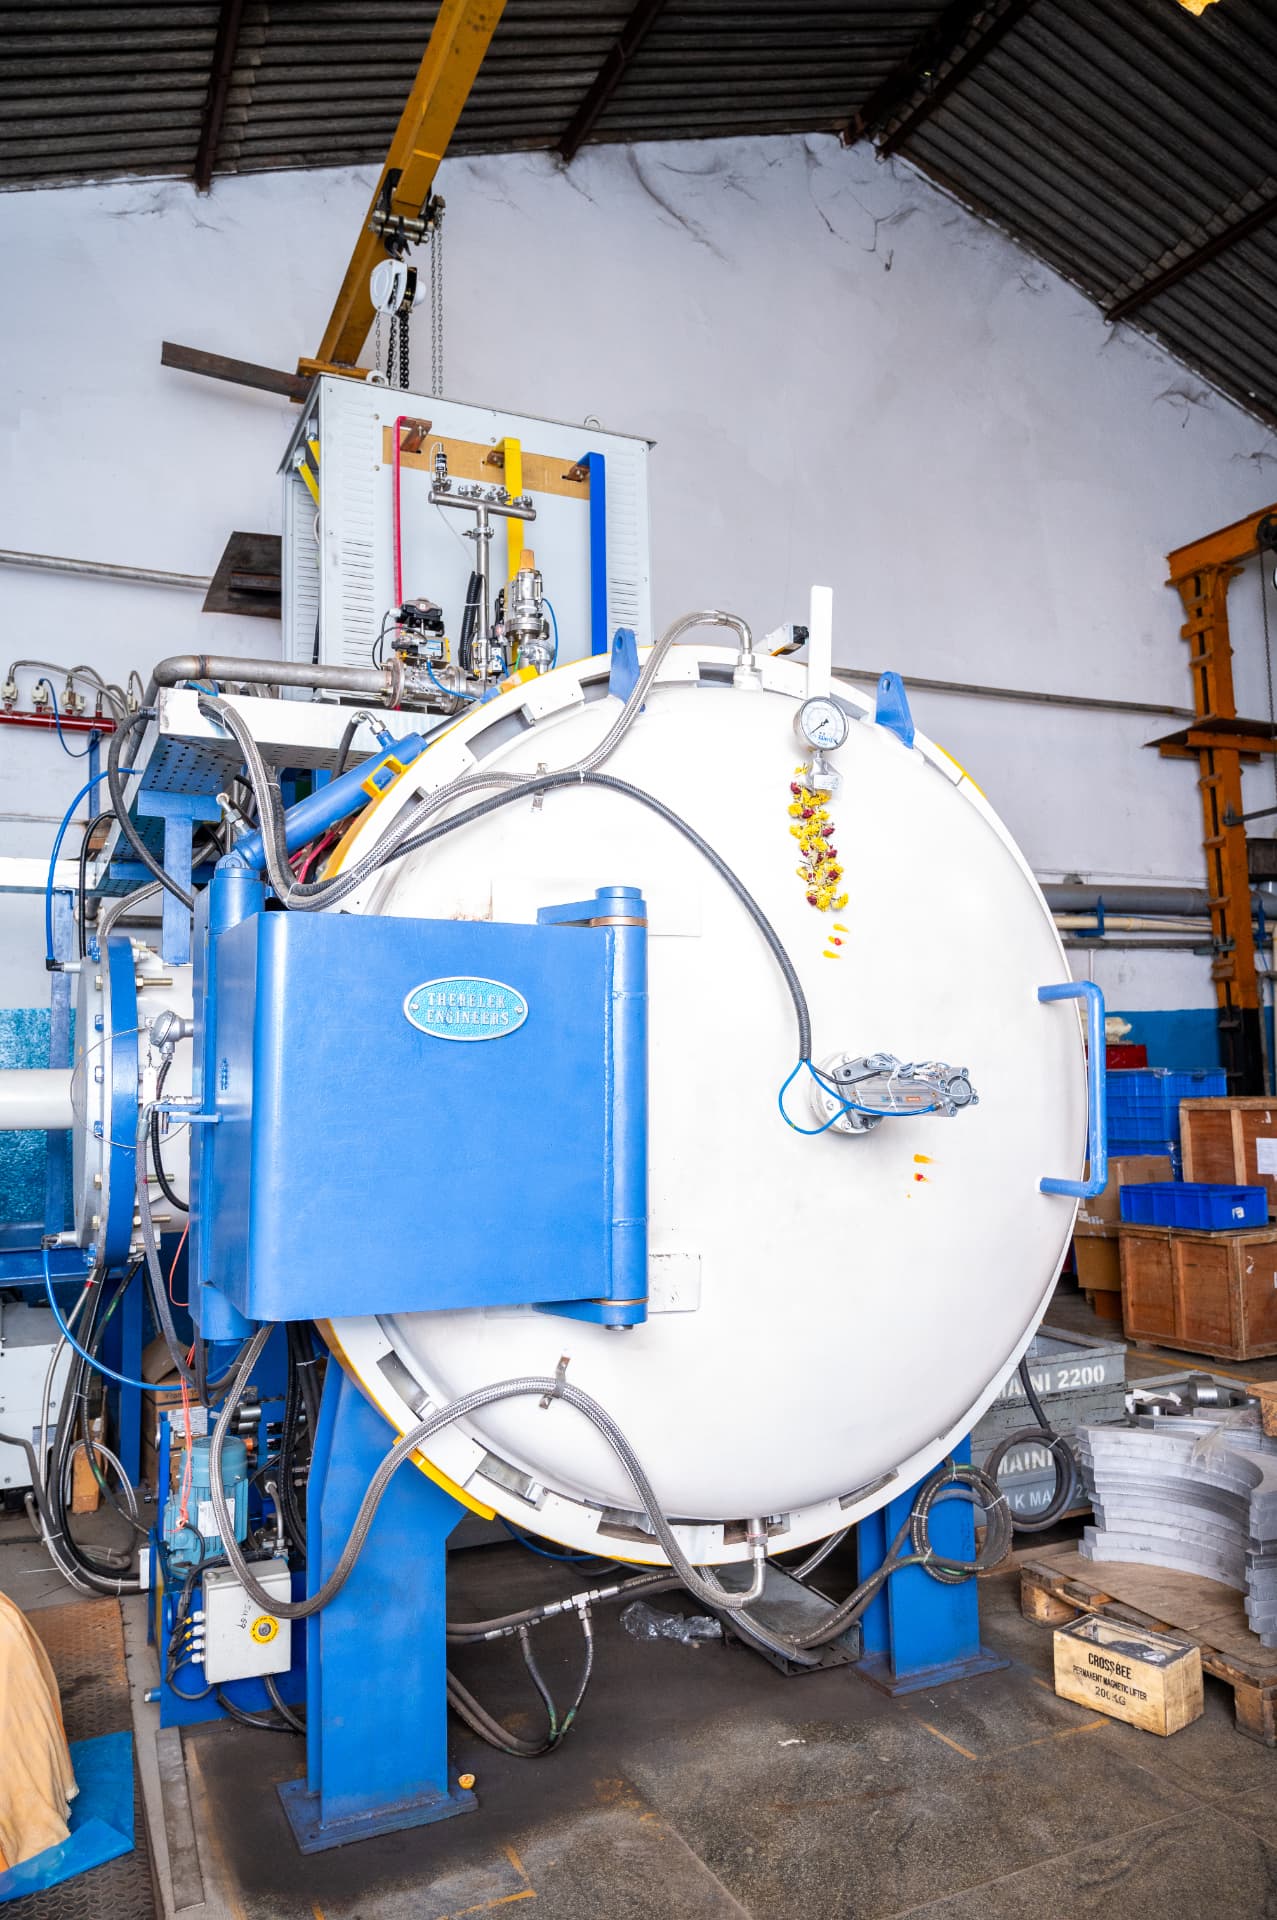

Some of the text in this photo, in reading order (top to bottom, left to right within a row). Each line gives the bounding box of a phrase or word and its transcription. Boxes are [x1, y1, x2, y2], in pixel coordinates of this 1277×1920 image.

[427, 1009, 509, 1025] ENGINEERS
[996, 1364, 1105, 1399] ANI 2200
[1072, 1664, 1148, 1701] PERMANENT MAGNETIC LIFTER
